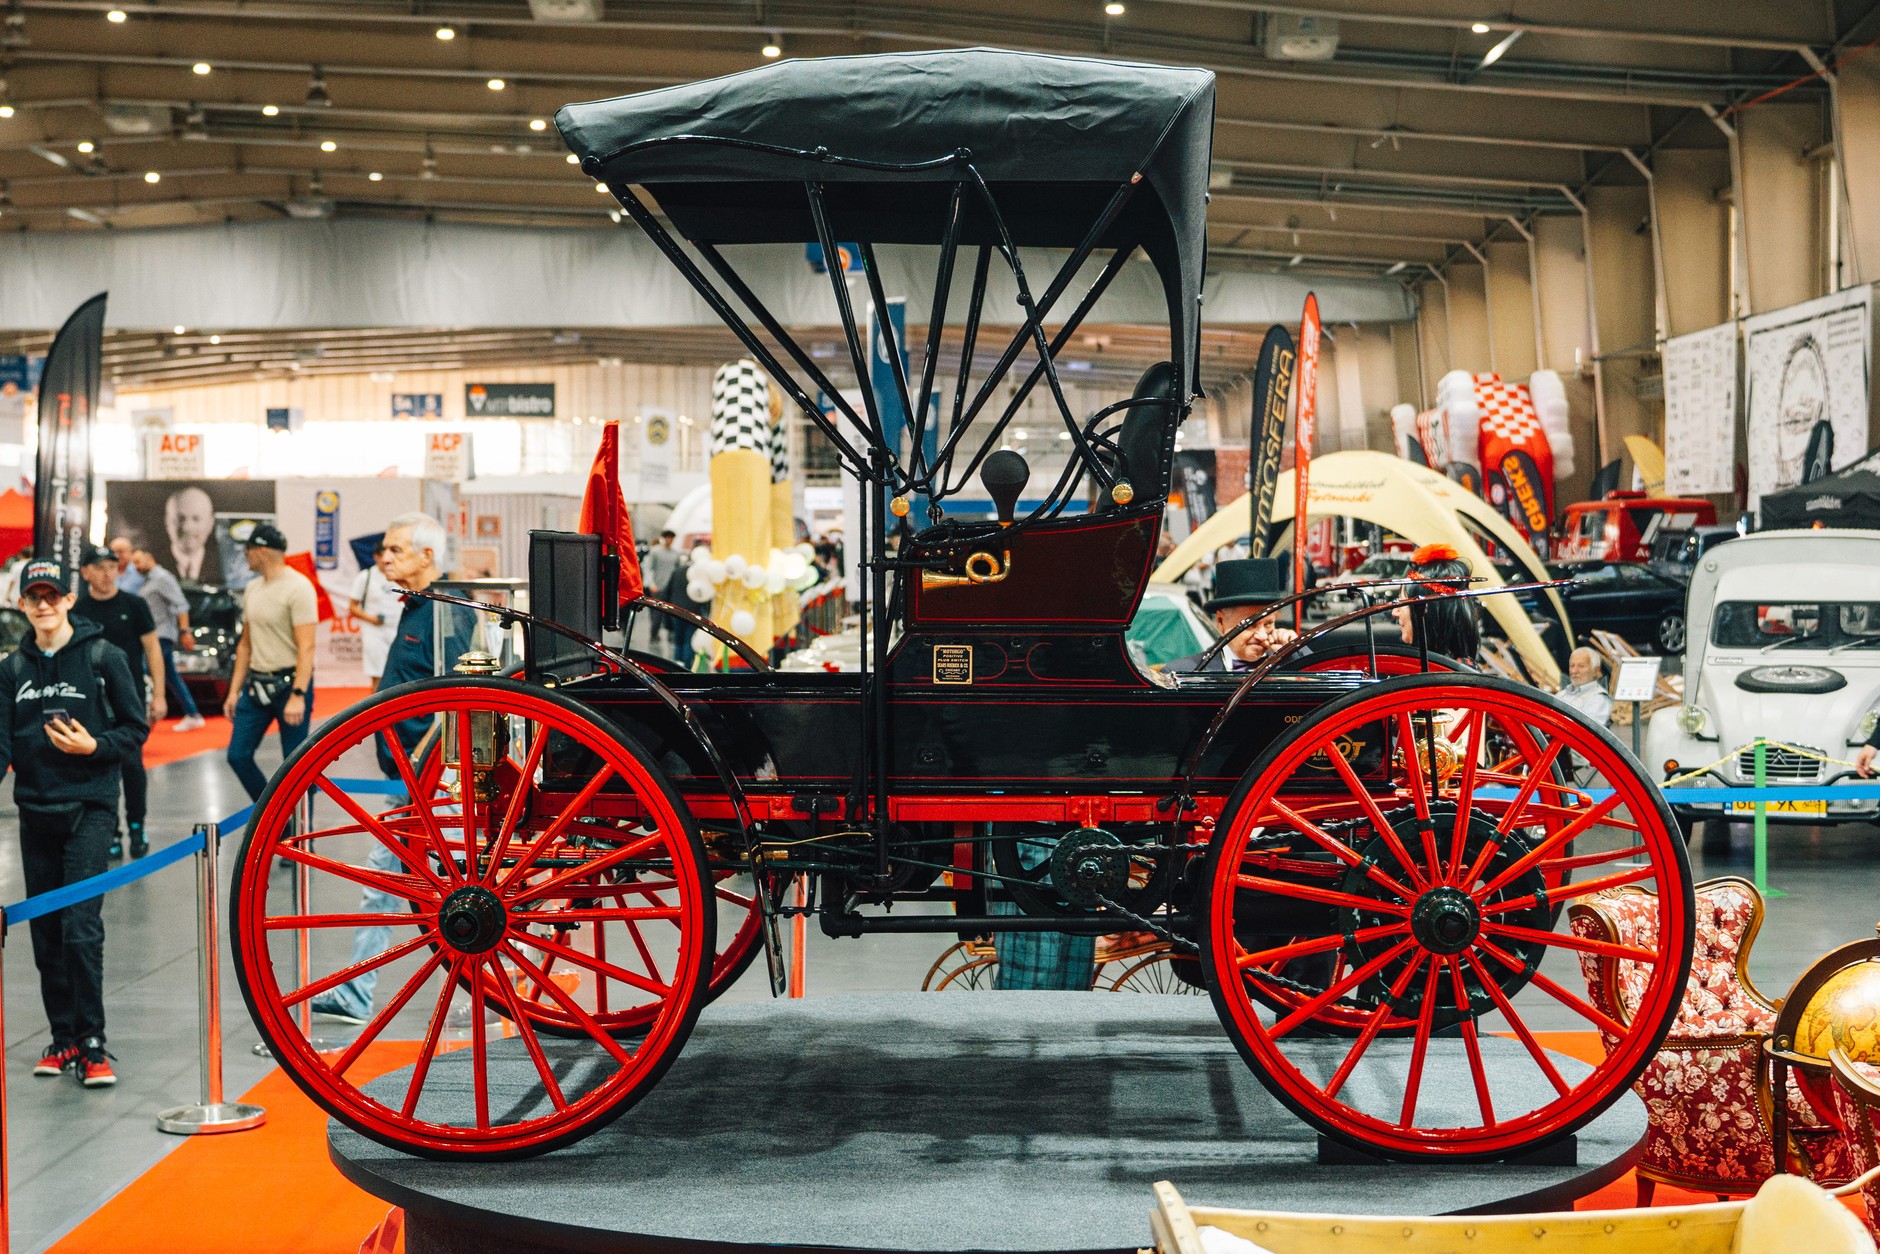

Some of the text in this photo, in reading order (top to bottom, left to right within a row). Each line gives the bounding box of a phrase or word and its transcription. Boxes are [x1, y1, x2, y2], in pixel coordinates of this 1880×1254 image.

[160, 434, 200, 453] ACP
[431, 432, 462, 451] ACP
[1252, 348, 1295, 560] ATMOSFERA
[330, 616, 361, 634] AC
